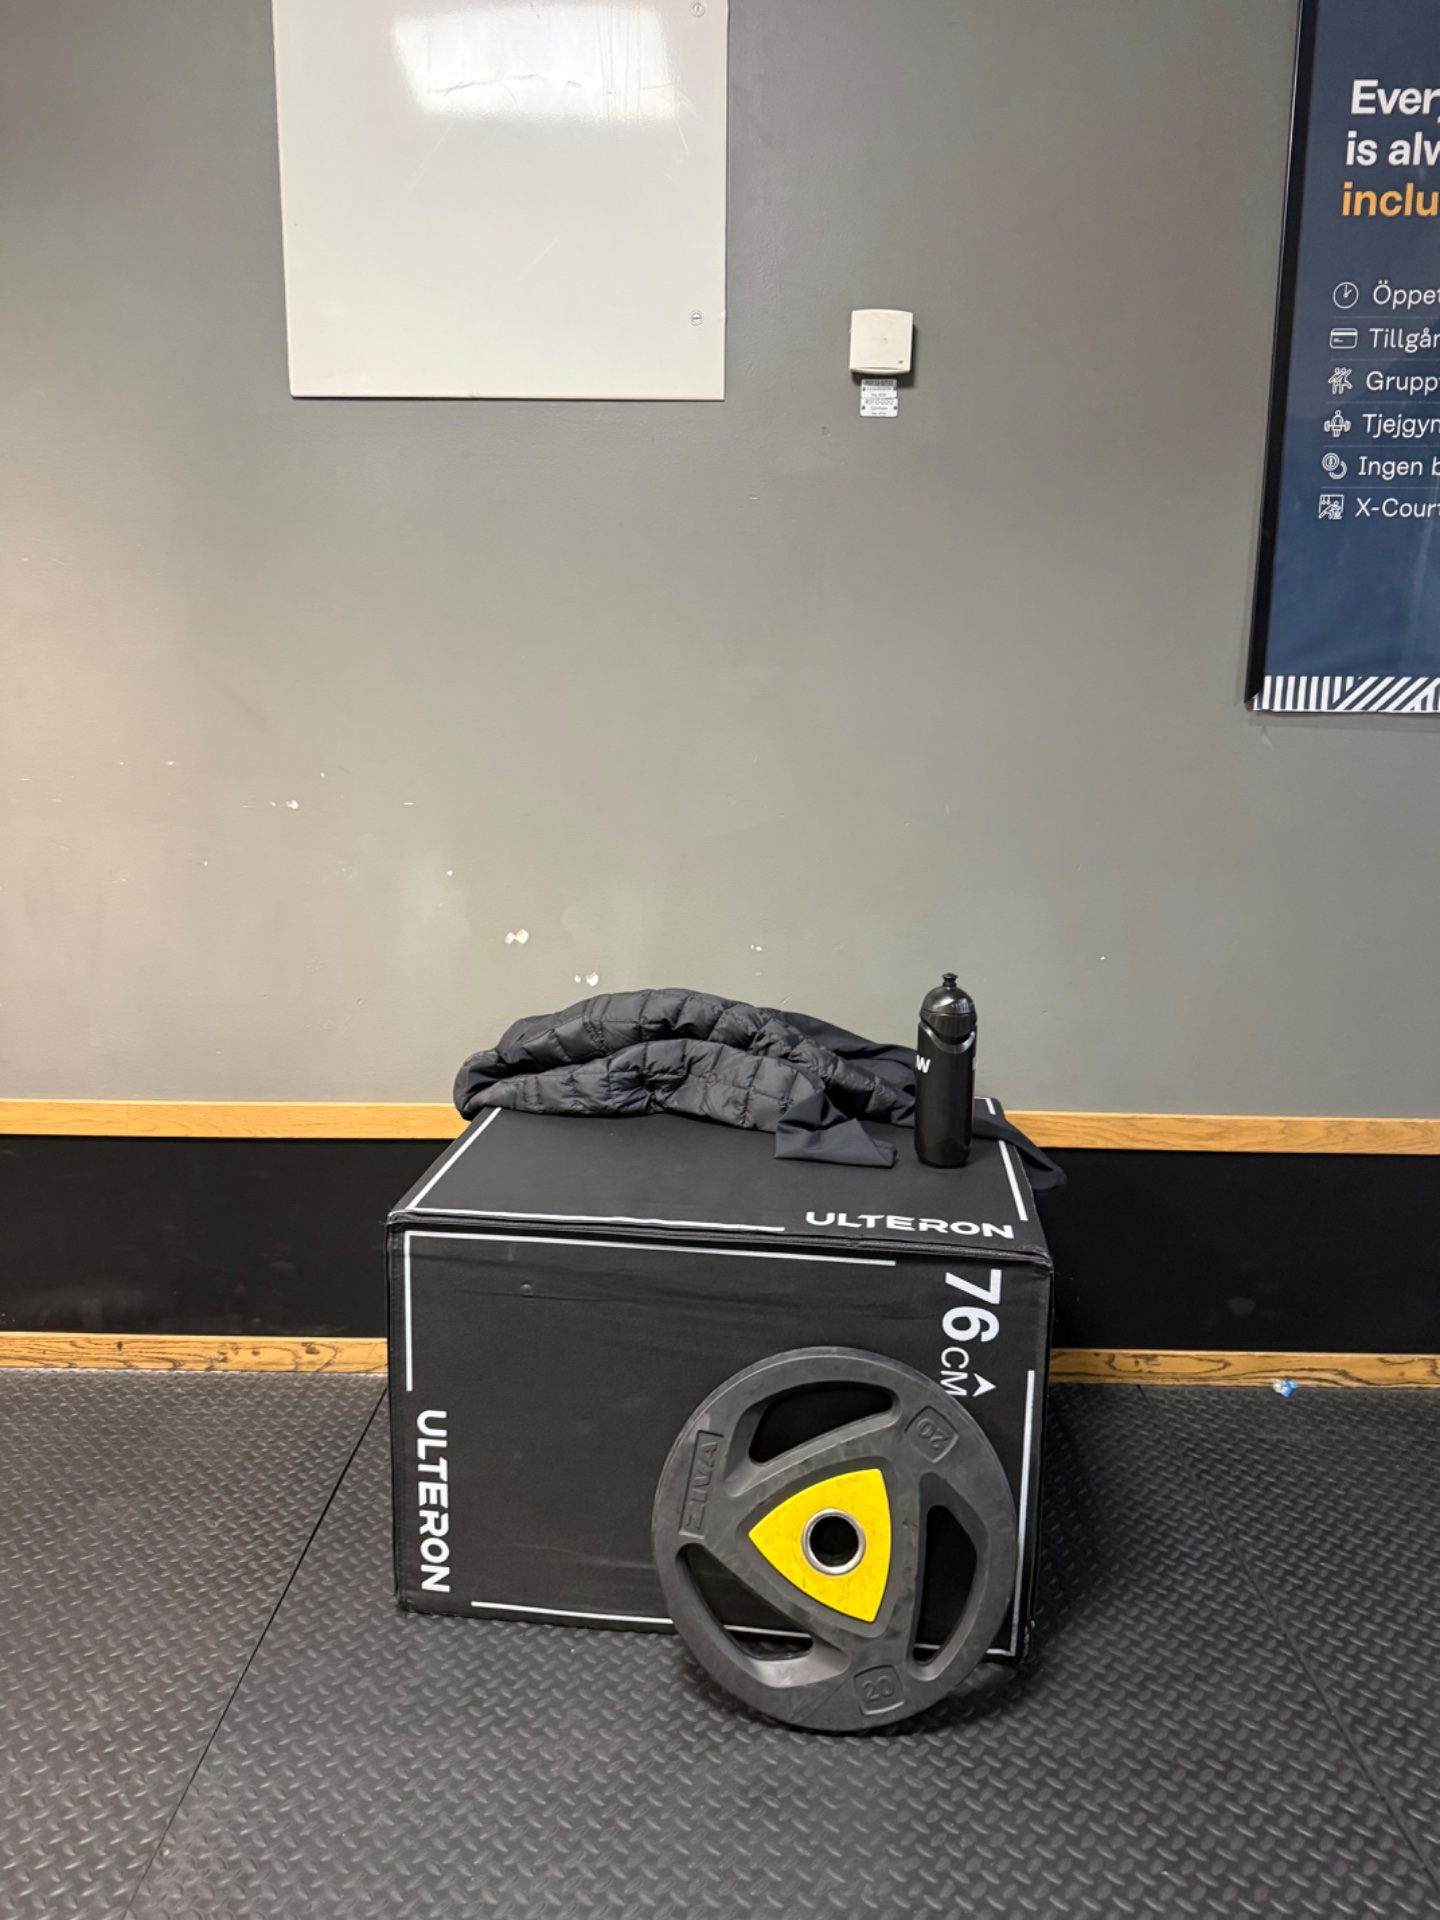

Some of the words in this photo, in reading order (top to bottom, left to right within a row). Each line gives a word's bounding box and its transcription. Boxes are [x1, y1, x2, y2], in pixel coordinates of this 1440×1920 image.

[1350, 79, 1440, 124] Ever
[1346, 130, 1378, 166] is
[1342, 181, 1439, 217] inclu
[1366, 371, 1440, 396] Grupp
[1357, 456, 1423, 480] Ingen
[805, 1211, 1015, 1239] ULTERON
[942, 1268, 1002, 1342] 76
[940, 1346, 970, 1396] CM
[416, 1409, 451, 1593] ULTERON
[684, 1440, 718, 1530] ZIVA
[862, 1675, 895, 1702] 20
